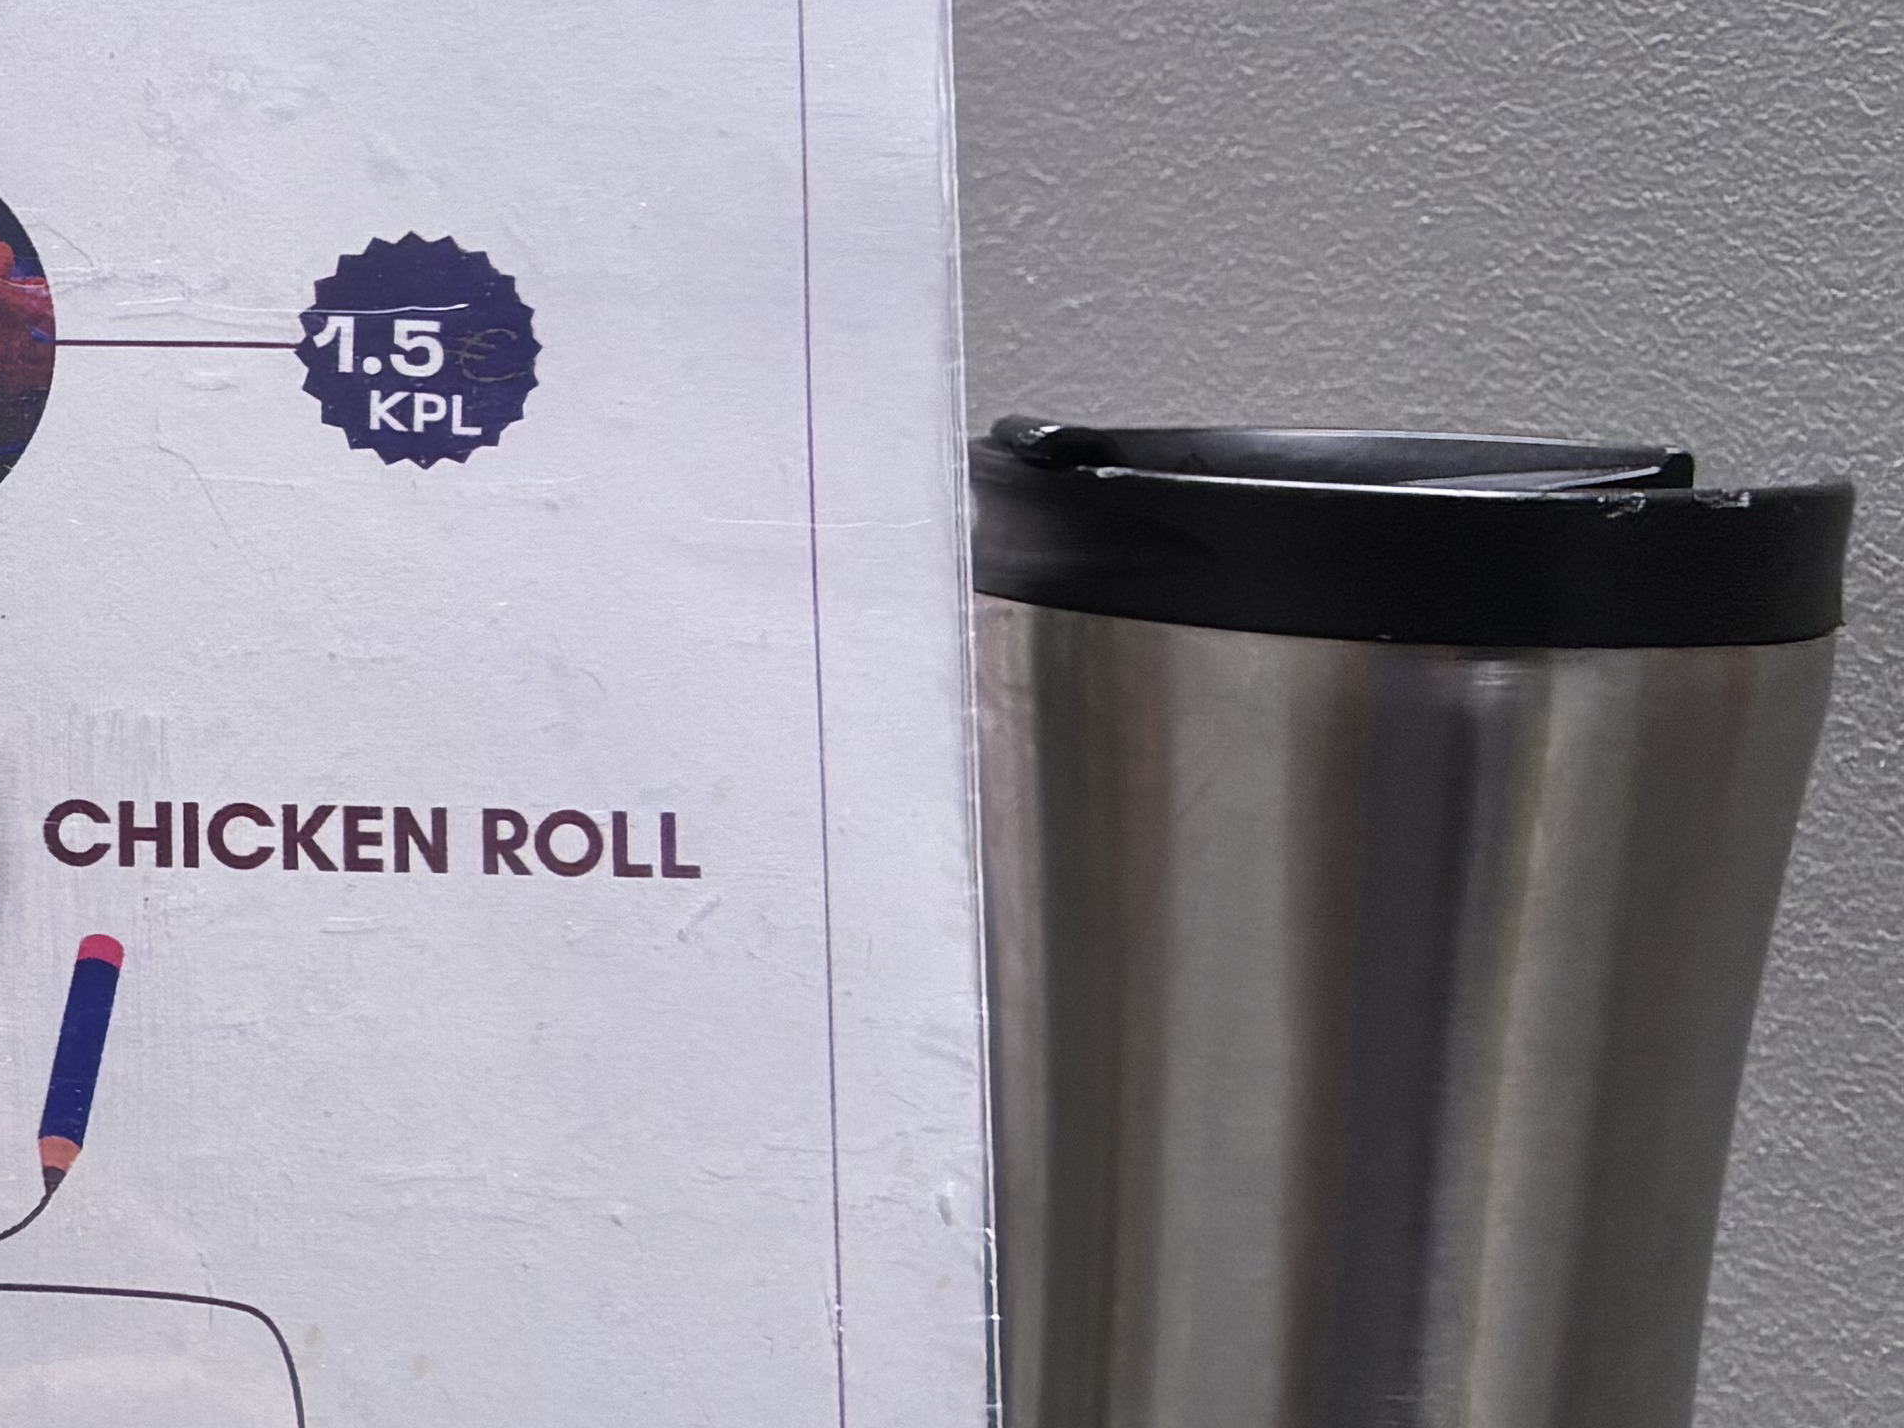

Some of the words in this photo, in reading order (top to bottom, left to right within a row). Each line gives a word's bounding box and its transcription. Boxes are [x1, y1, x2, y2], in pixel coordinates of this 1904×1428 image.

[313, 316, 444, 377] 1.5
[369, 390, 482, 435] KPL
[43, 799, 447, 873] CHICKEN
[483, 809, 701, 878] ROLL
